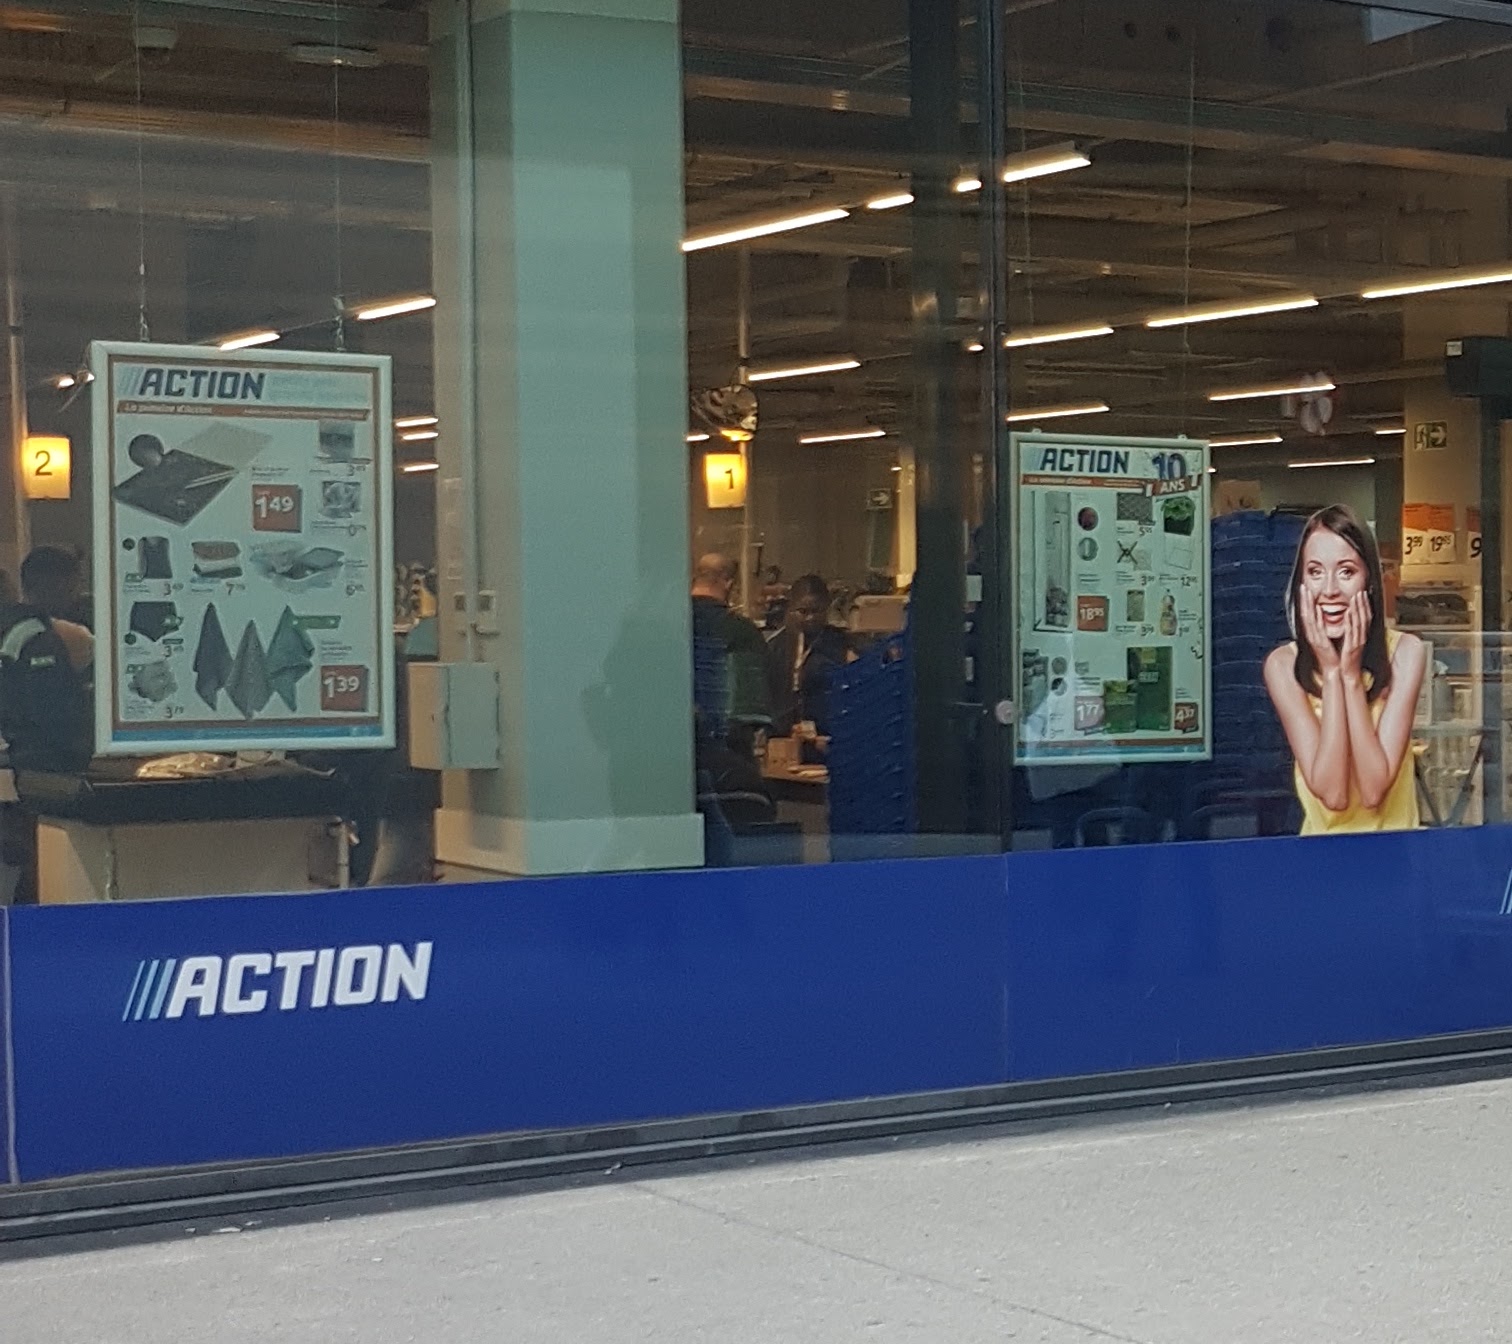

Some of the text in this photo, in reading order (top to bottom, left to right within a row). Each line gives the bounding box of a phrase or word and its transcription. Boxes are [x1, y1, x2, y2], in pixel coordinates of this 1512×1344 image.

[139, 368, 265, 400] ACTION
[35, 450, 53, 476] 2
[1040, 448, 1129, 474] ACTION
[1152, 452, 1187, 480] 10
[725, 468, 734, 490] 1
[1159, 479, 1186, 494] ANS
[165, 942, 433, 1018] ACTION
